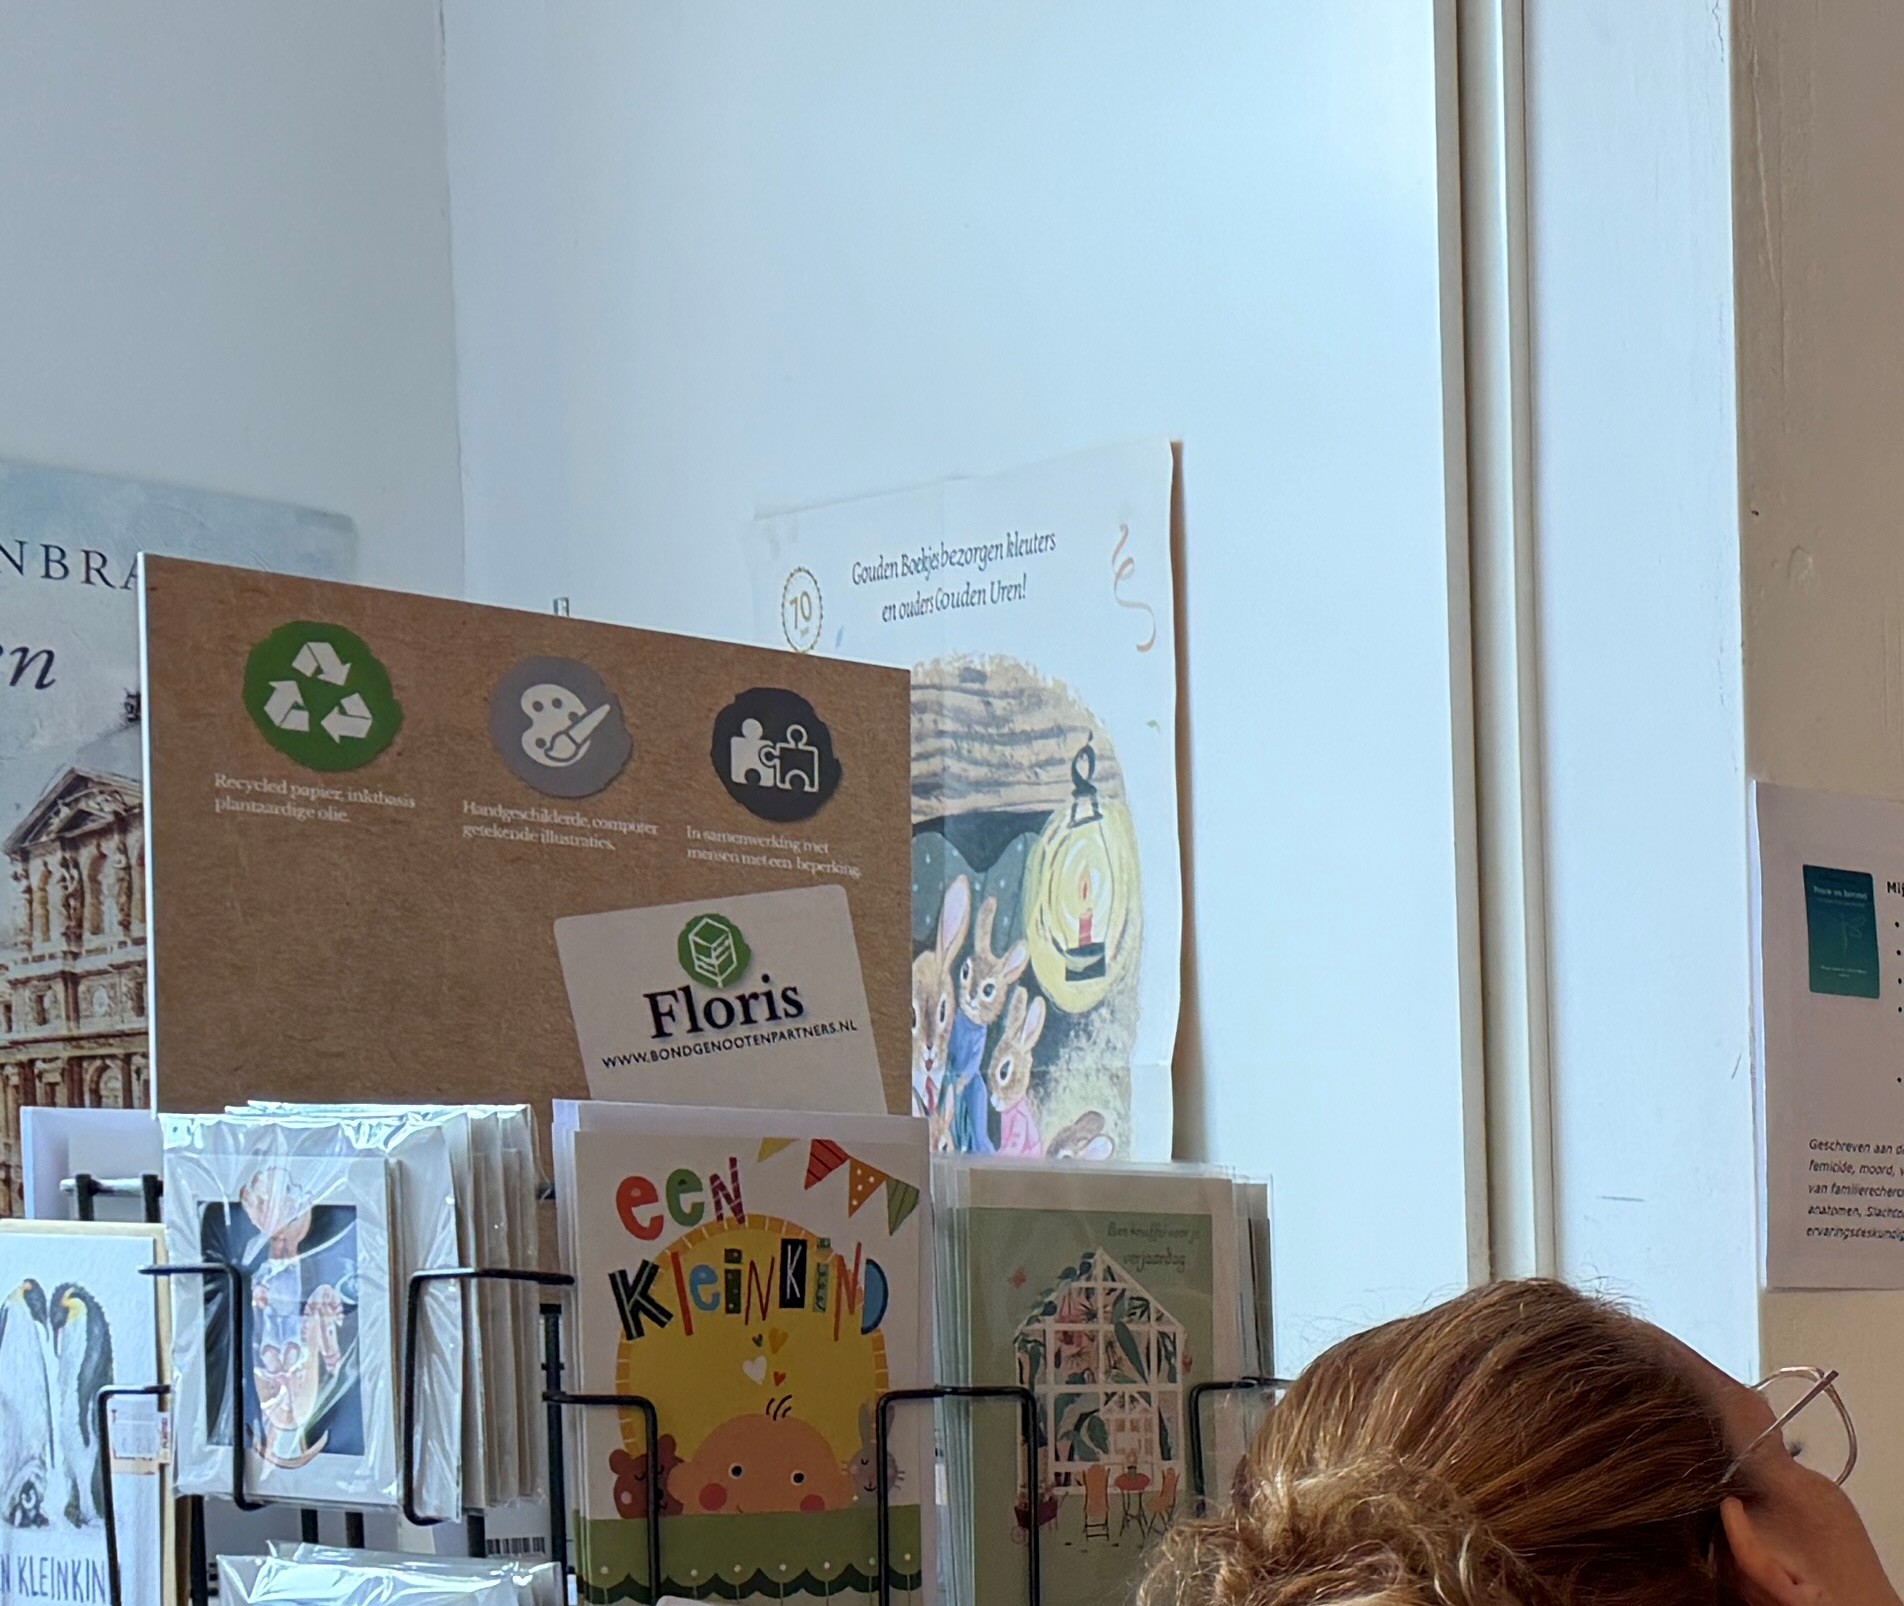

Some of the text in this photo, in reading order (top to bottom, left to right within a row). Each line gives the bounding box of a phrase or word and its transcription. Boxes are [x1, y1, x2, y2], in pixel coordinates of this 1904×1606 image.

[852, 530, 1056, 585] Gouden Boekjes bezorgen kleuters
[882, 573, 1027, 622] en ouders Gouden Uren!
[687, 848, 740, 864] mensen
[703, 829, 800, 854] samenwerking
[803, 841, 829, 854] met
[643, 974, 804, 1039] Floris
[602, 1019, 858, 1068] WWW.BONDGENOOTENPARTNERS.NL
[18, 1555, 112, 1606] KLEINKIN
